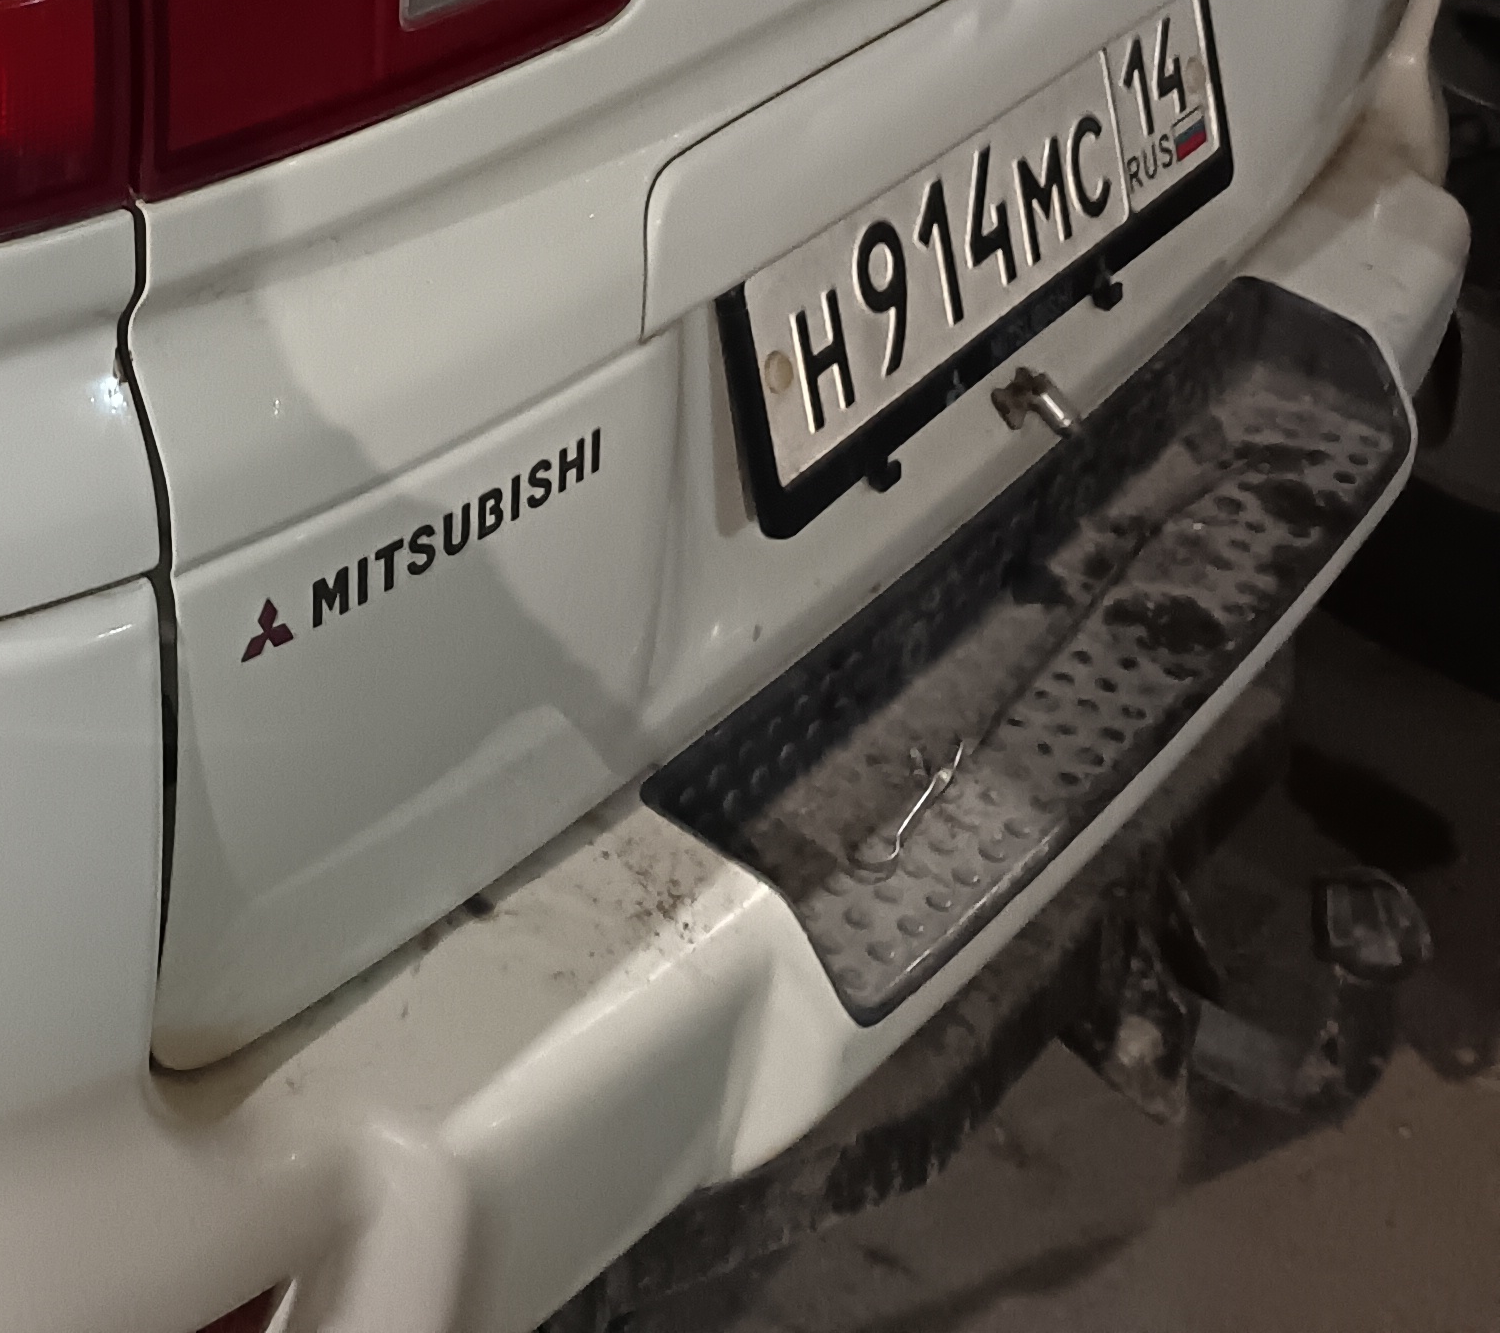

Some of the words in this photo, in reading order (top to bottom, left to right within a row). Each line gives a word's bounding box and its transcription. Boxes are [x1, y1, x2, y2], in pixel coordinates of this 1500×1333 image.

[1119, 17, 1187, 136] 14
[1126, 134, 1174, 192] RUS
[312, 426, 601, 628] MITSUBISHI
